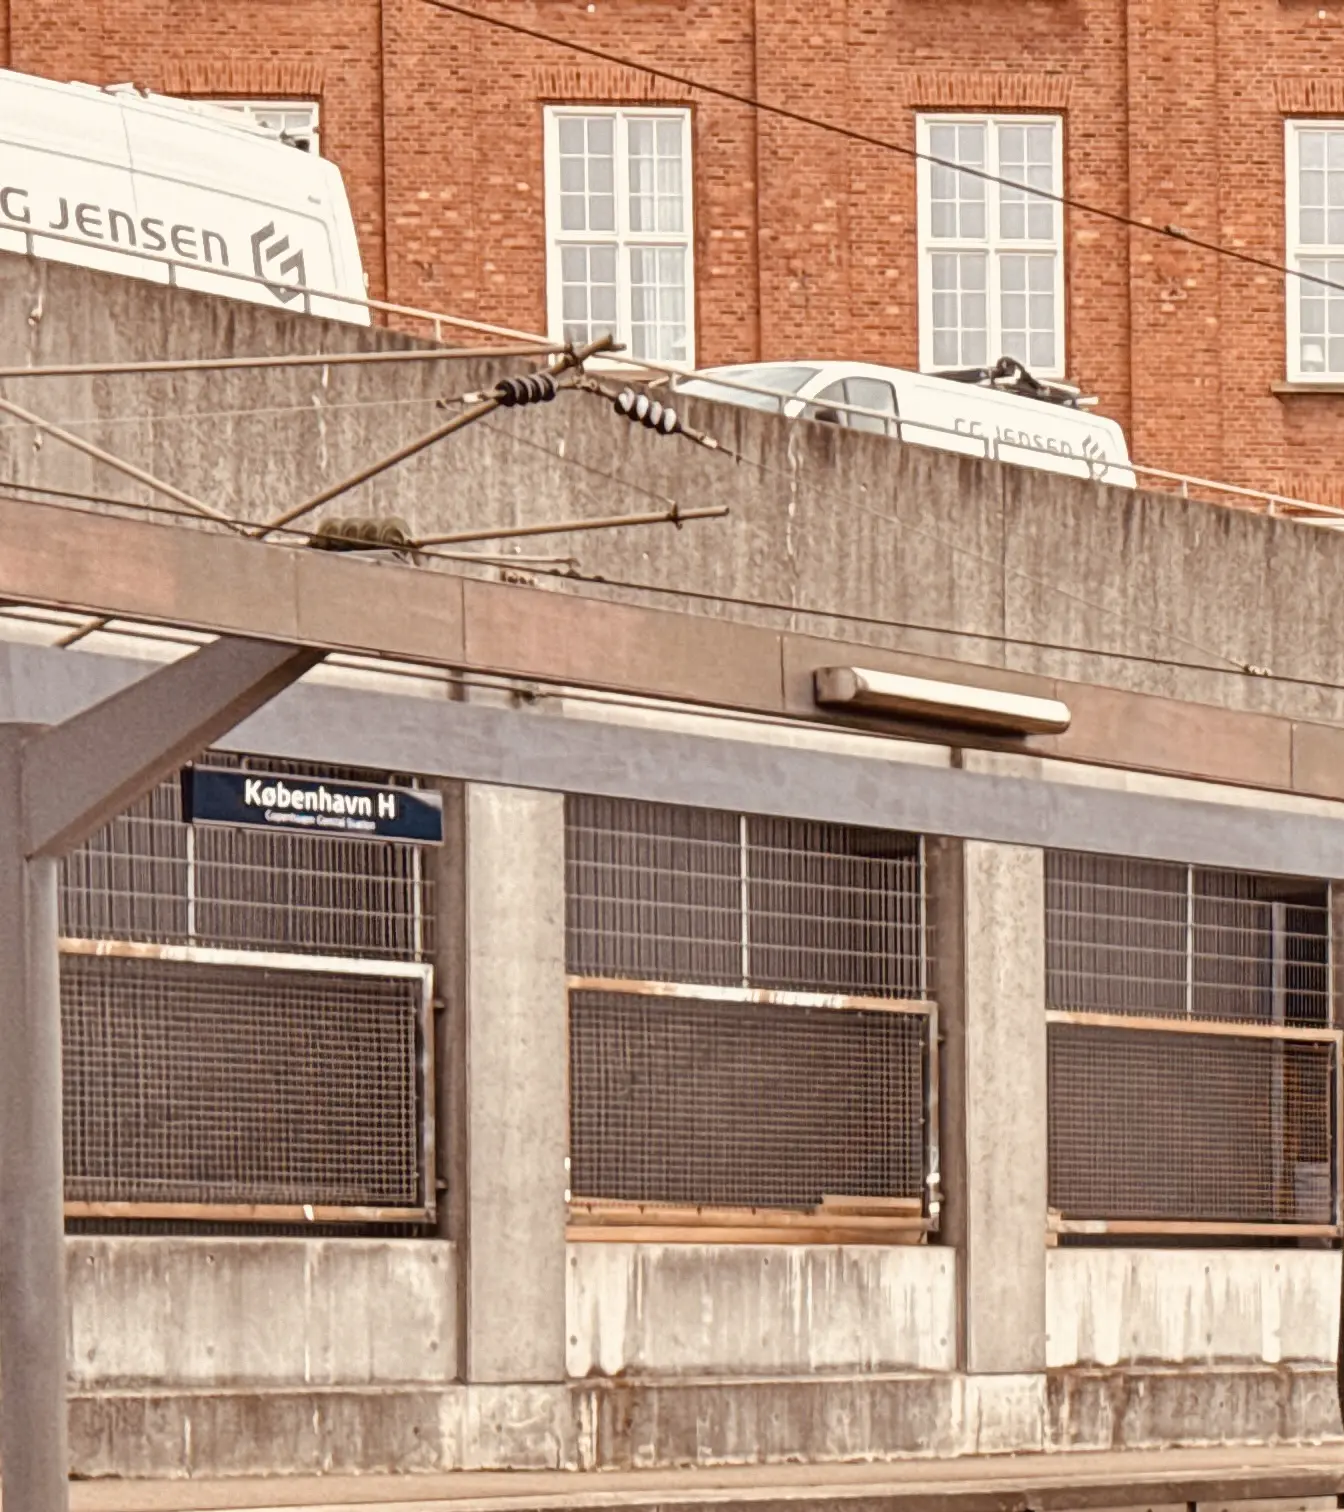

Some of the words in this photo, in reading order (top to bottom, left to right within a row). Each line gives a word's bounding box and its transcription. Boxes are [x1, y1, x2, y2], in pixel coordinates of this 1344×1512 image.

[49, 197, 230, 266] JENSEN
[244, 778, 372, 817] København
[378, 793, 396, 819] H
